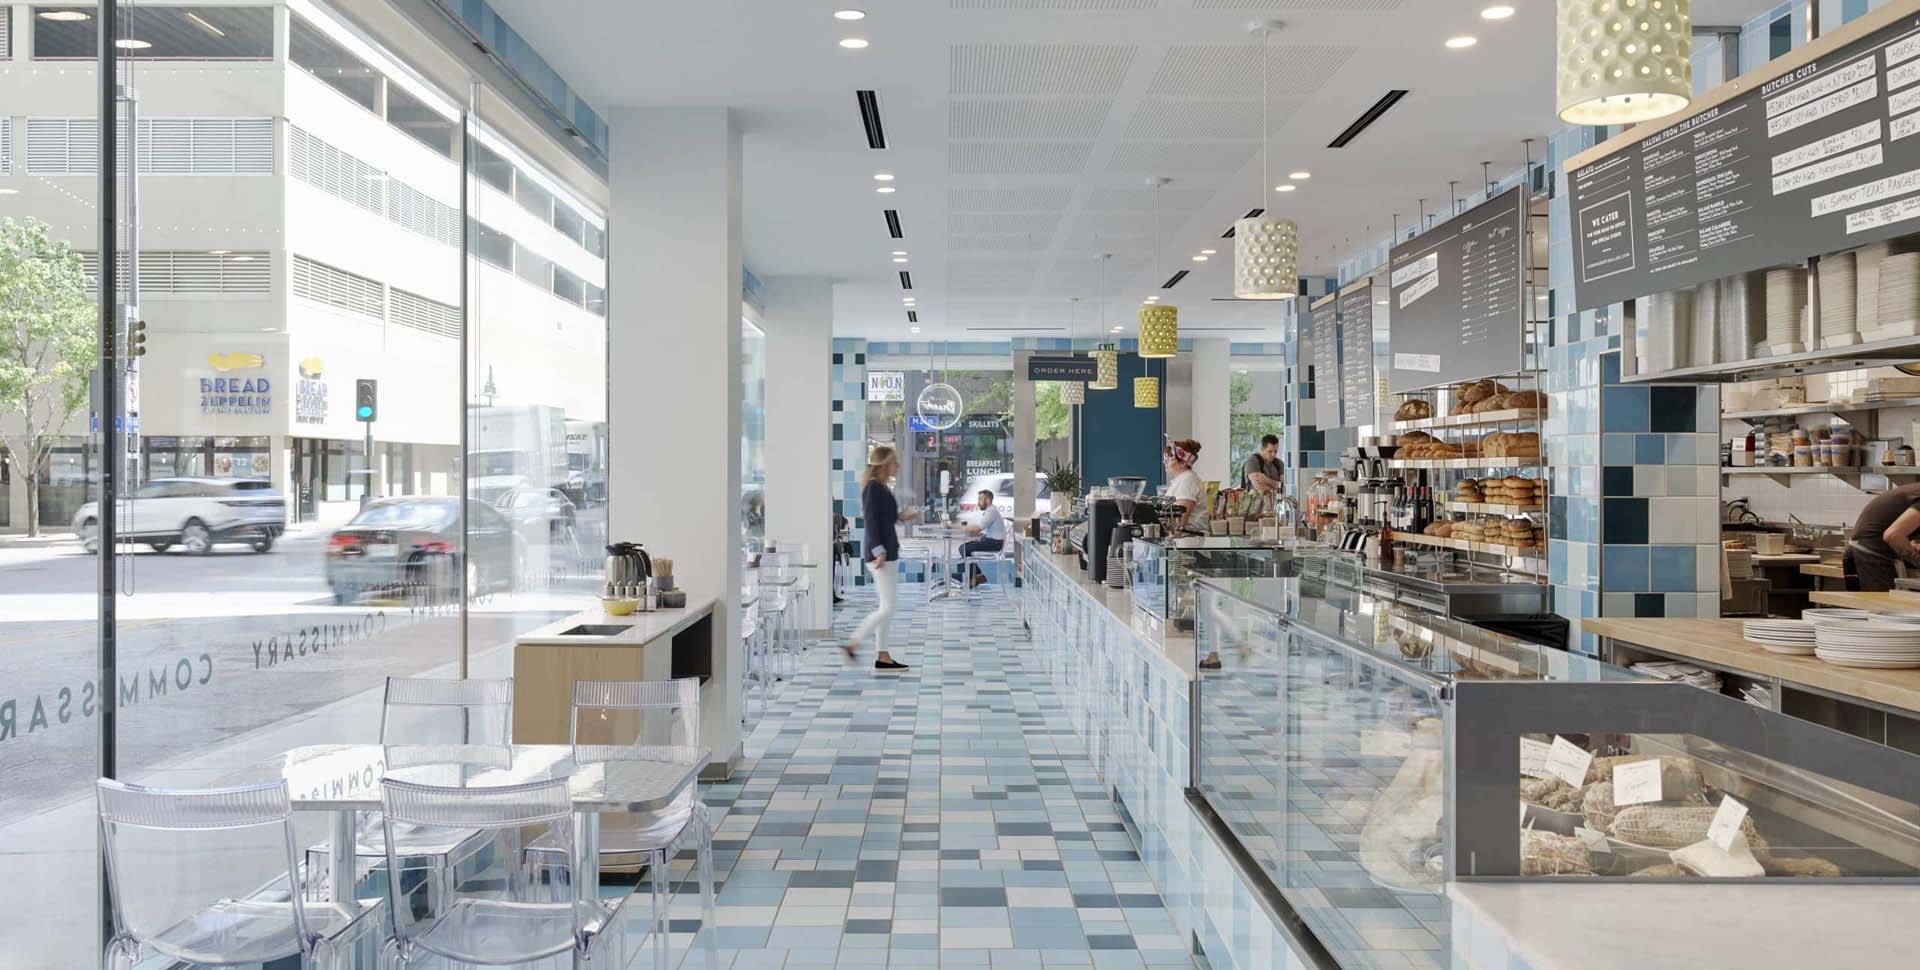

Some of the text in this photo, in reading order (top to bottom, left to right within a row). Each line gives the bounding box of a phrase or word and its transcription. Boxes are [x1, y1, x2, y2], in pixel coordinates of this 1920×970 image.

[1761, 63, 1817, 94] BUTCHER CUTS
[1642, 134, 1662, 149] SALUMI
[1662, 126, 1678, 139] FROM
[1680, 120, 1690, 131] THE
[1692, 107, 1719, 126] BUTCHER
[1601, 211, 1619, 225] CATER
[200, 378, 270, 393] BREAD
[200, 396, 271, 407] ZEPPELIN
[968, 420, 1000, 428] SKILLETS
